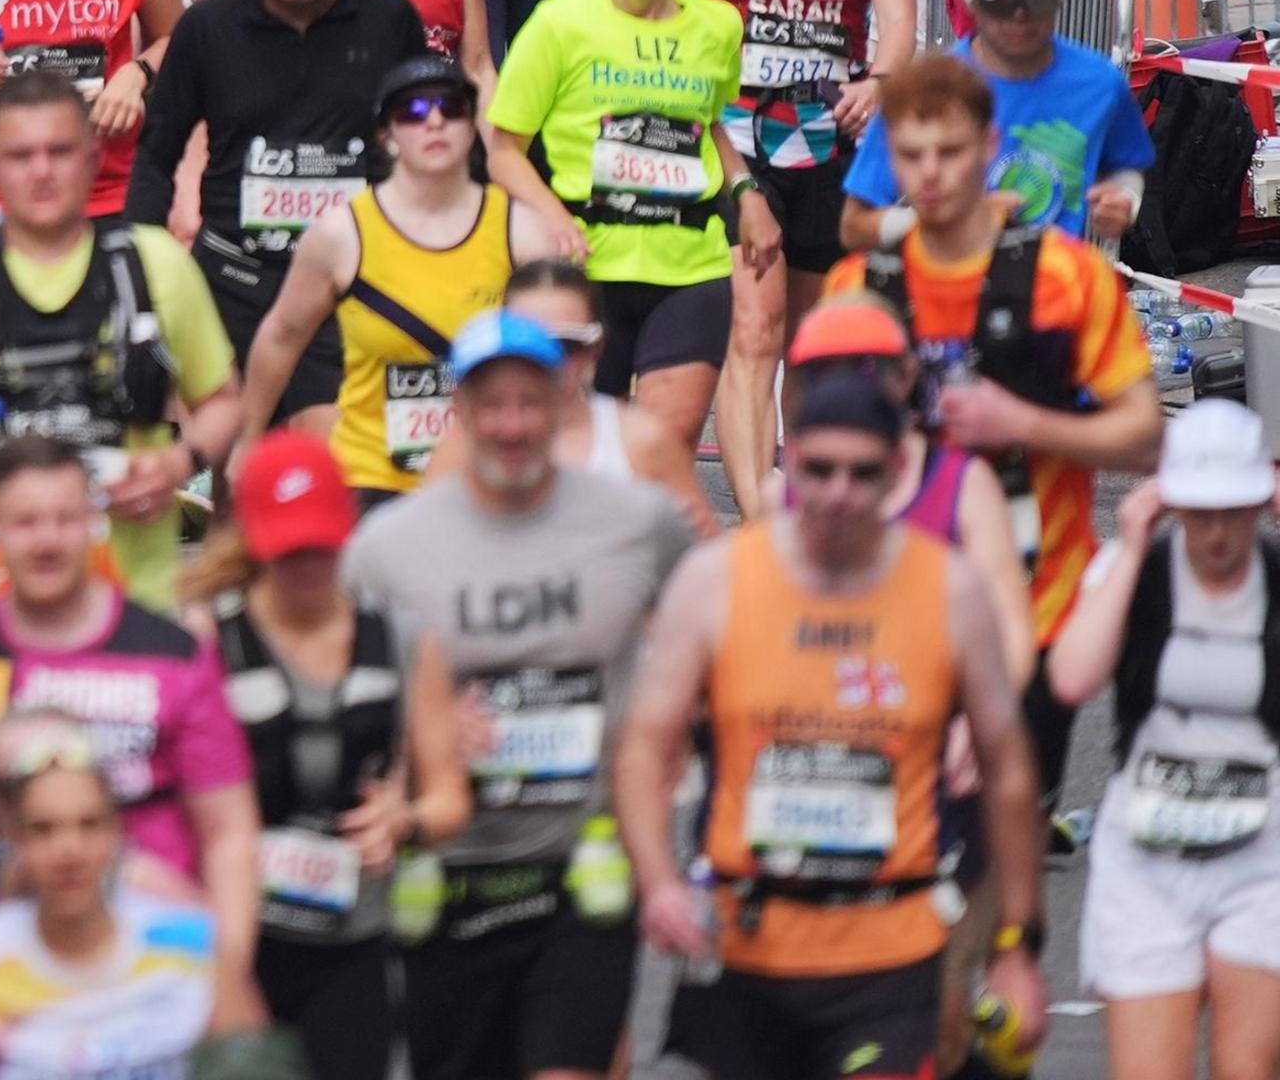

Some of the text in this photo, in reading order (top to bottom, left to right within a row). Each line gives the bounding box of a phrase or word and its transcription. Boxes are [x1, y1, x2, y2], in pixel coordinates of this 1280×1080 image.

[750, 15, 790, 45] tcs
[635, 36, 683, 65] LIZ
[591, 61, 715, 101] Headway
[759, 56, 835, 85] 57877
[250, 136, 295, 176] tcs
